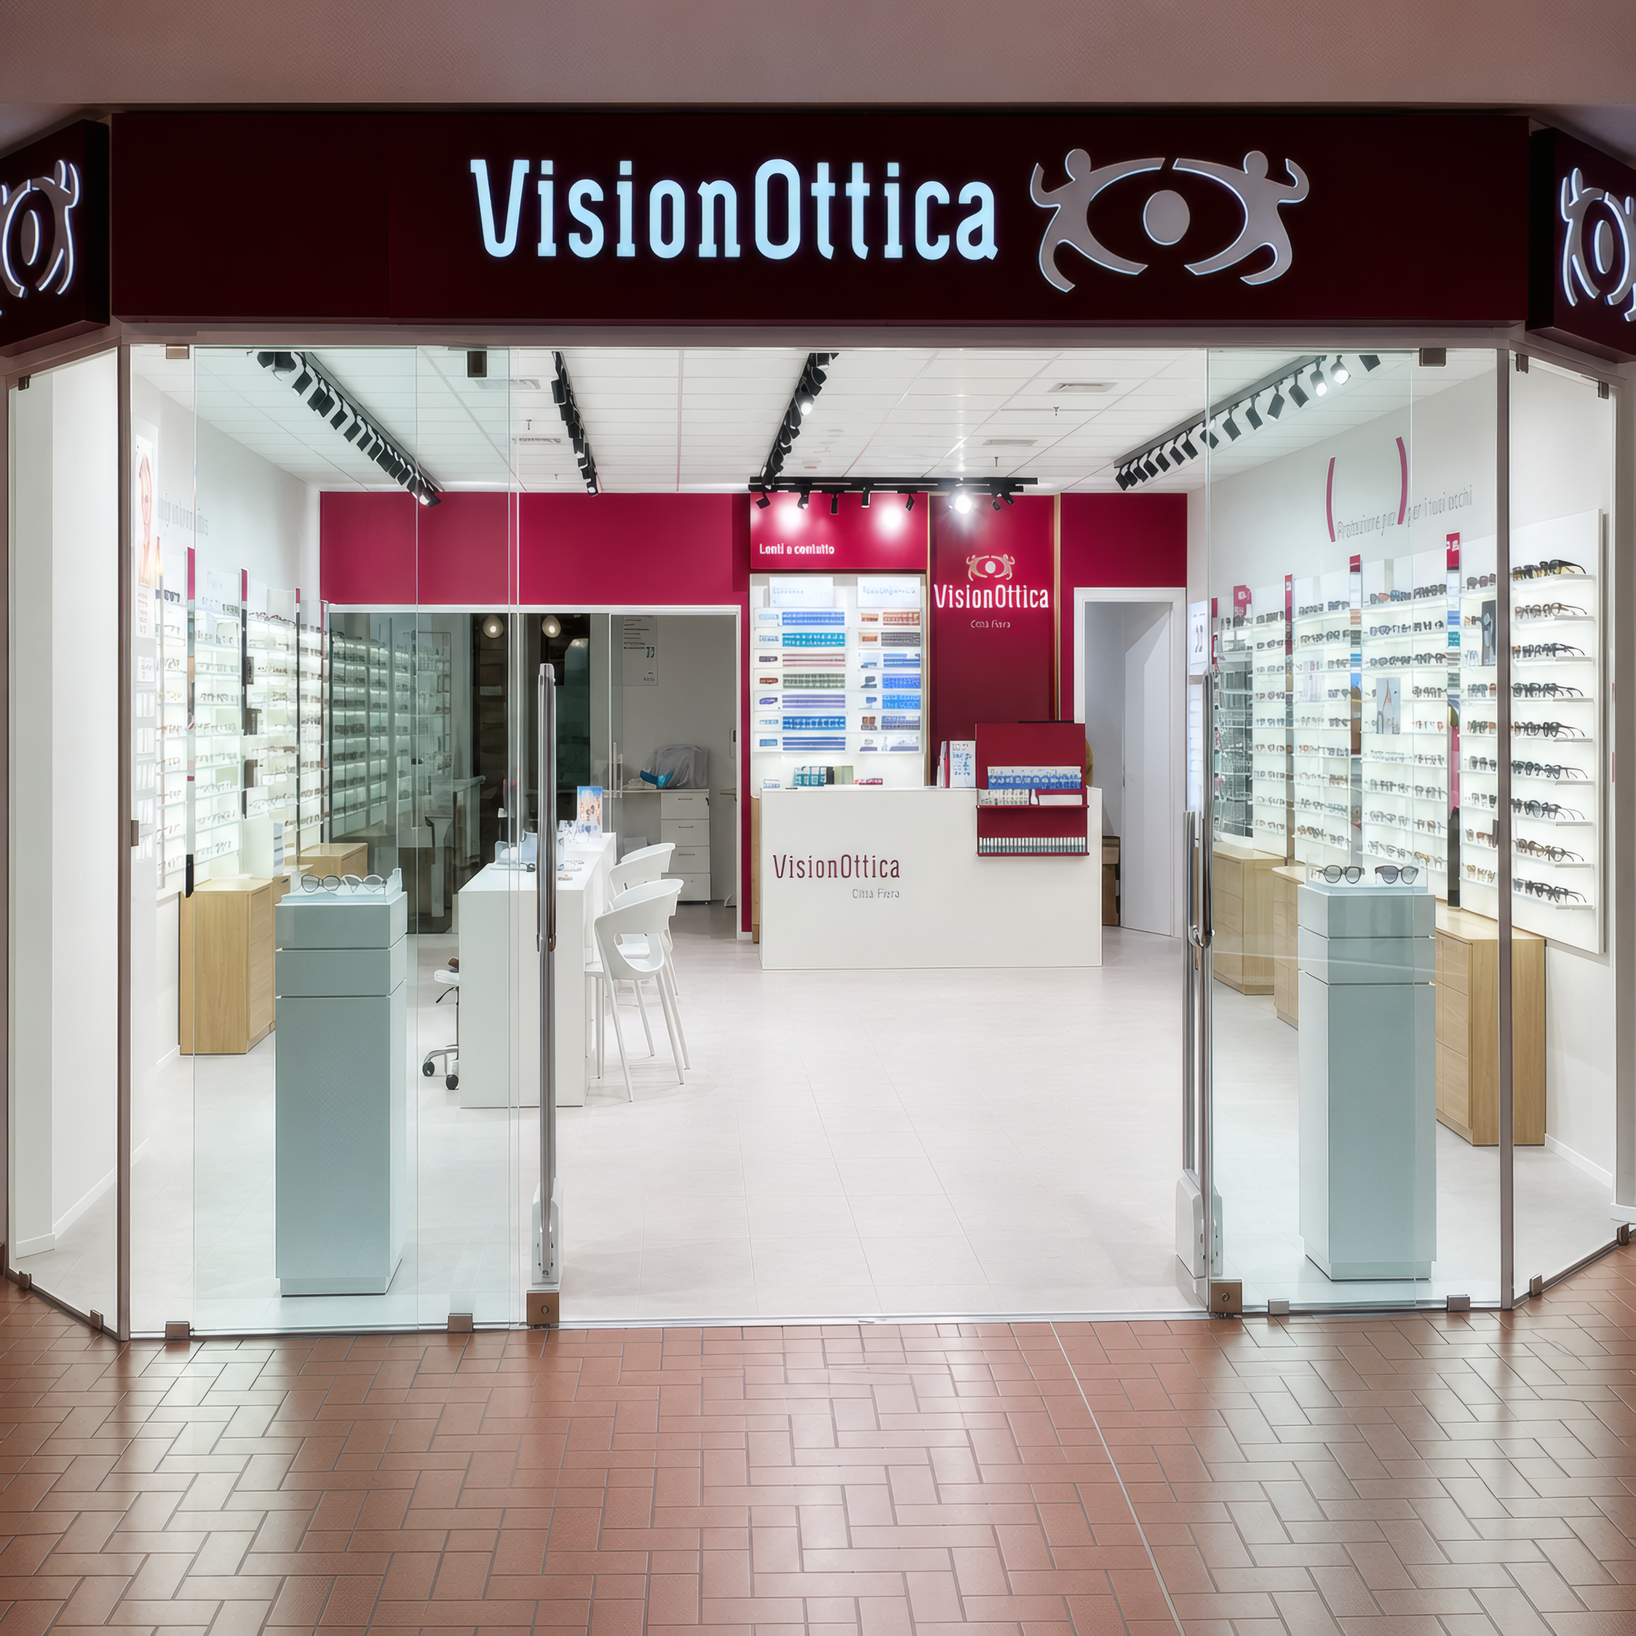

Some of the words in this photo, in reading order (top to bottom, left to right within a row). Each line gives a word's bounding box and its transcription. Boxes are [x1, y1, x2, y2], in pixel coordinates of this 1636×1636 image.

[470, 158, 999, 260] VisionOttica
[933, 584, 1049, 608] VisionOttica
[772, 854, 900, 879] VisionOttica
